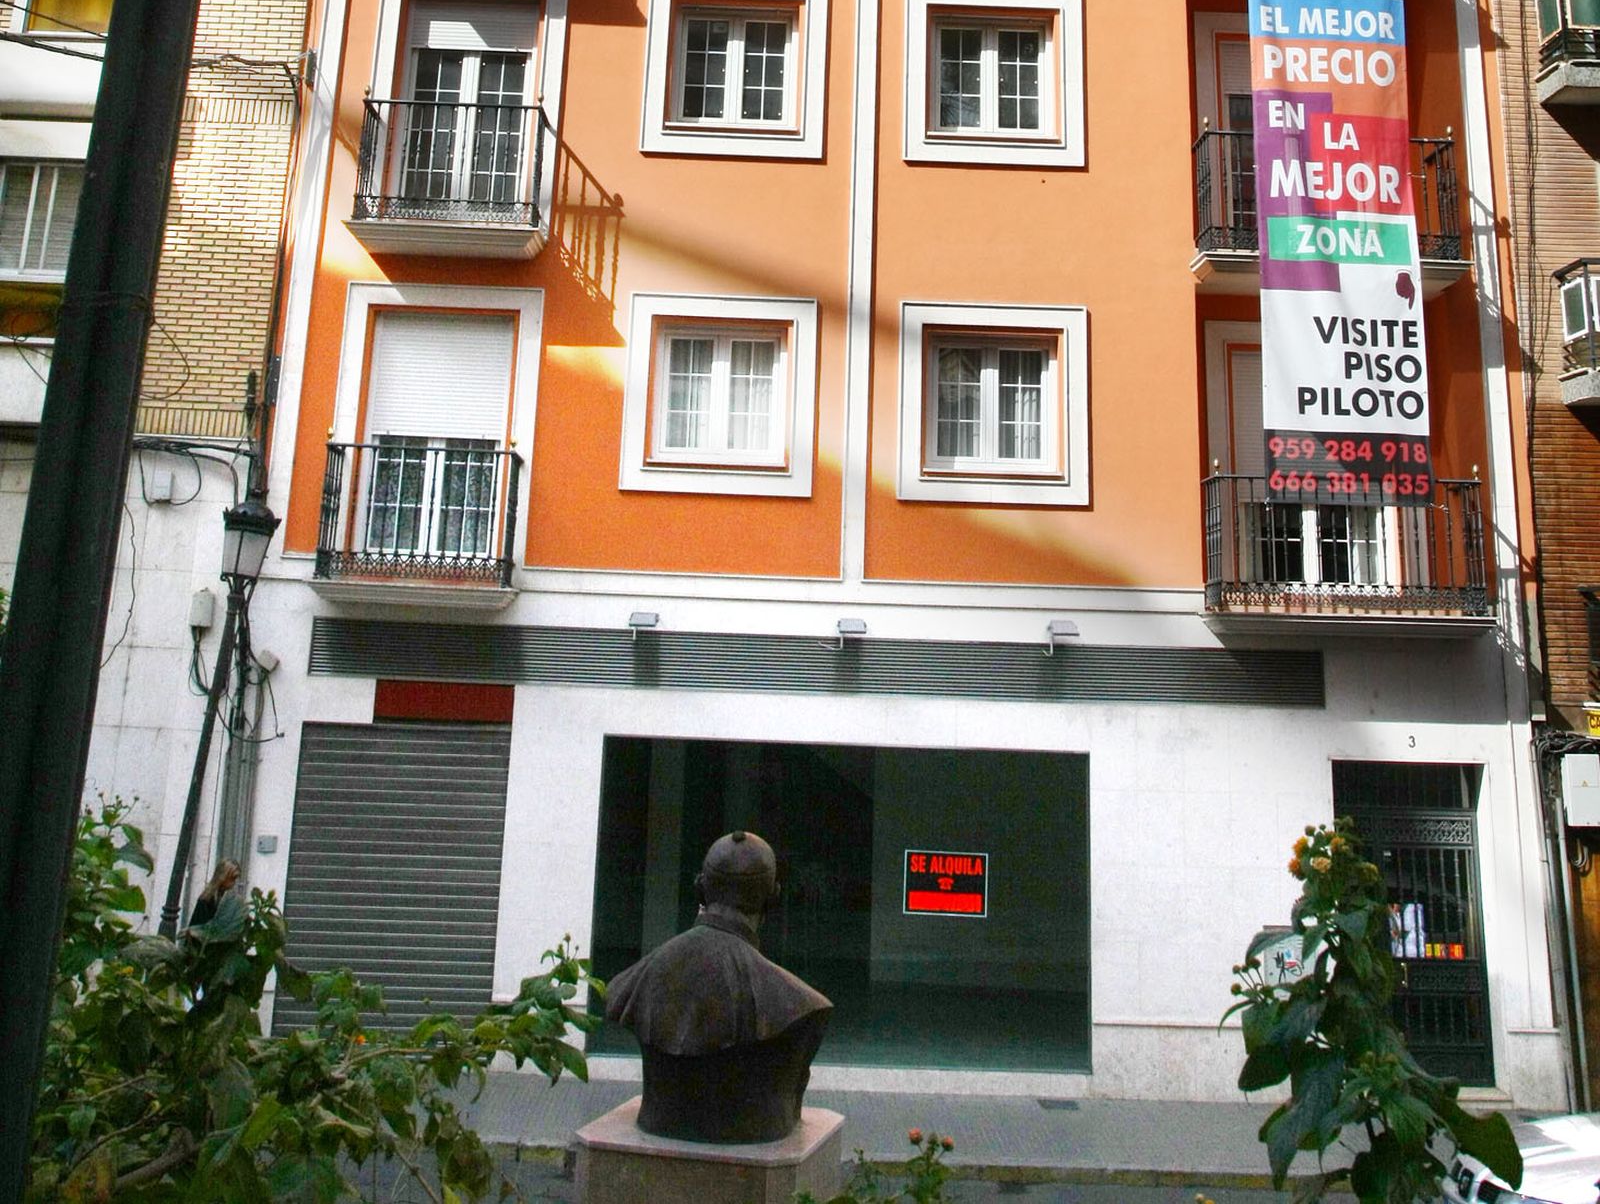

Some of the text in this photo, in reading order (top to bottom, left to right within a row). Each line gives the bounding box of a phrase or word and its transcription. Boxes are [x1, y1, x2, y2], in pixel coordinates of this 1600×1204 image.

[1260, 5, 1395, 40] EL MEJOR
[1263, 45, 1396, 87] PRECIO
[1268, 100, 1305, 130] EN
[1323, 122, 1360, 151] LA
[1270, 159, 1401, 204] MEJOR
[1296, 224, 1384, 258] ZONA
[1313, 316, 1419, 348] VISITE
[1344, 351, 1422, 383] PISO
[1297, 386, 1424, 420] PILOTO
[1268, 437, 1428, 464] 959 284 918
[1268, 470, 1429, 495] 666 381 035
[1408, 735, 1416, 748] 3
[910, 854, 983, 876] SE ALQUILA
